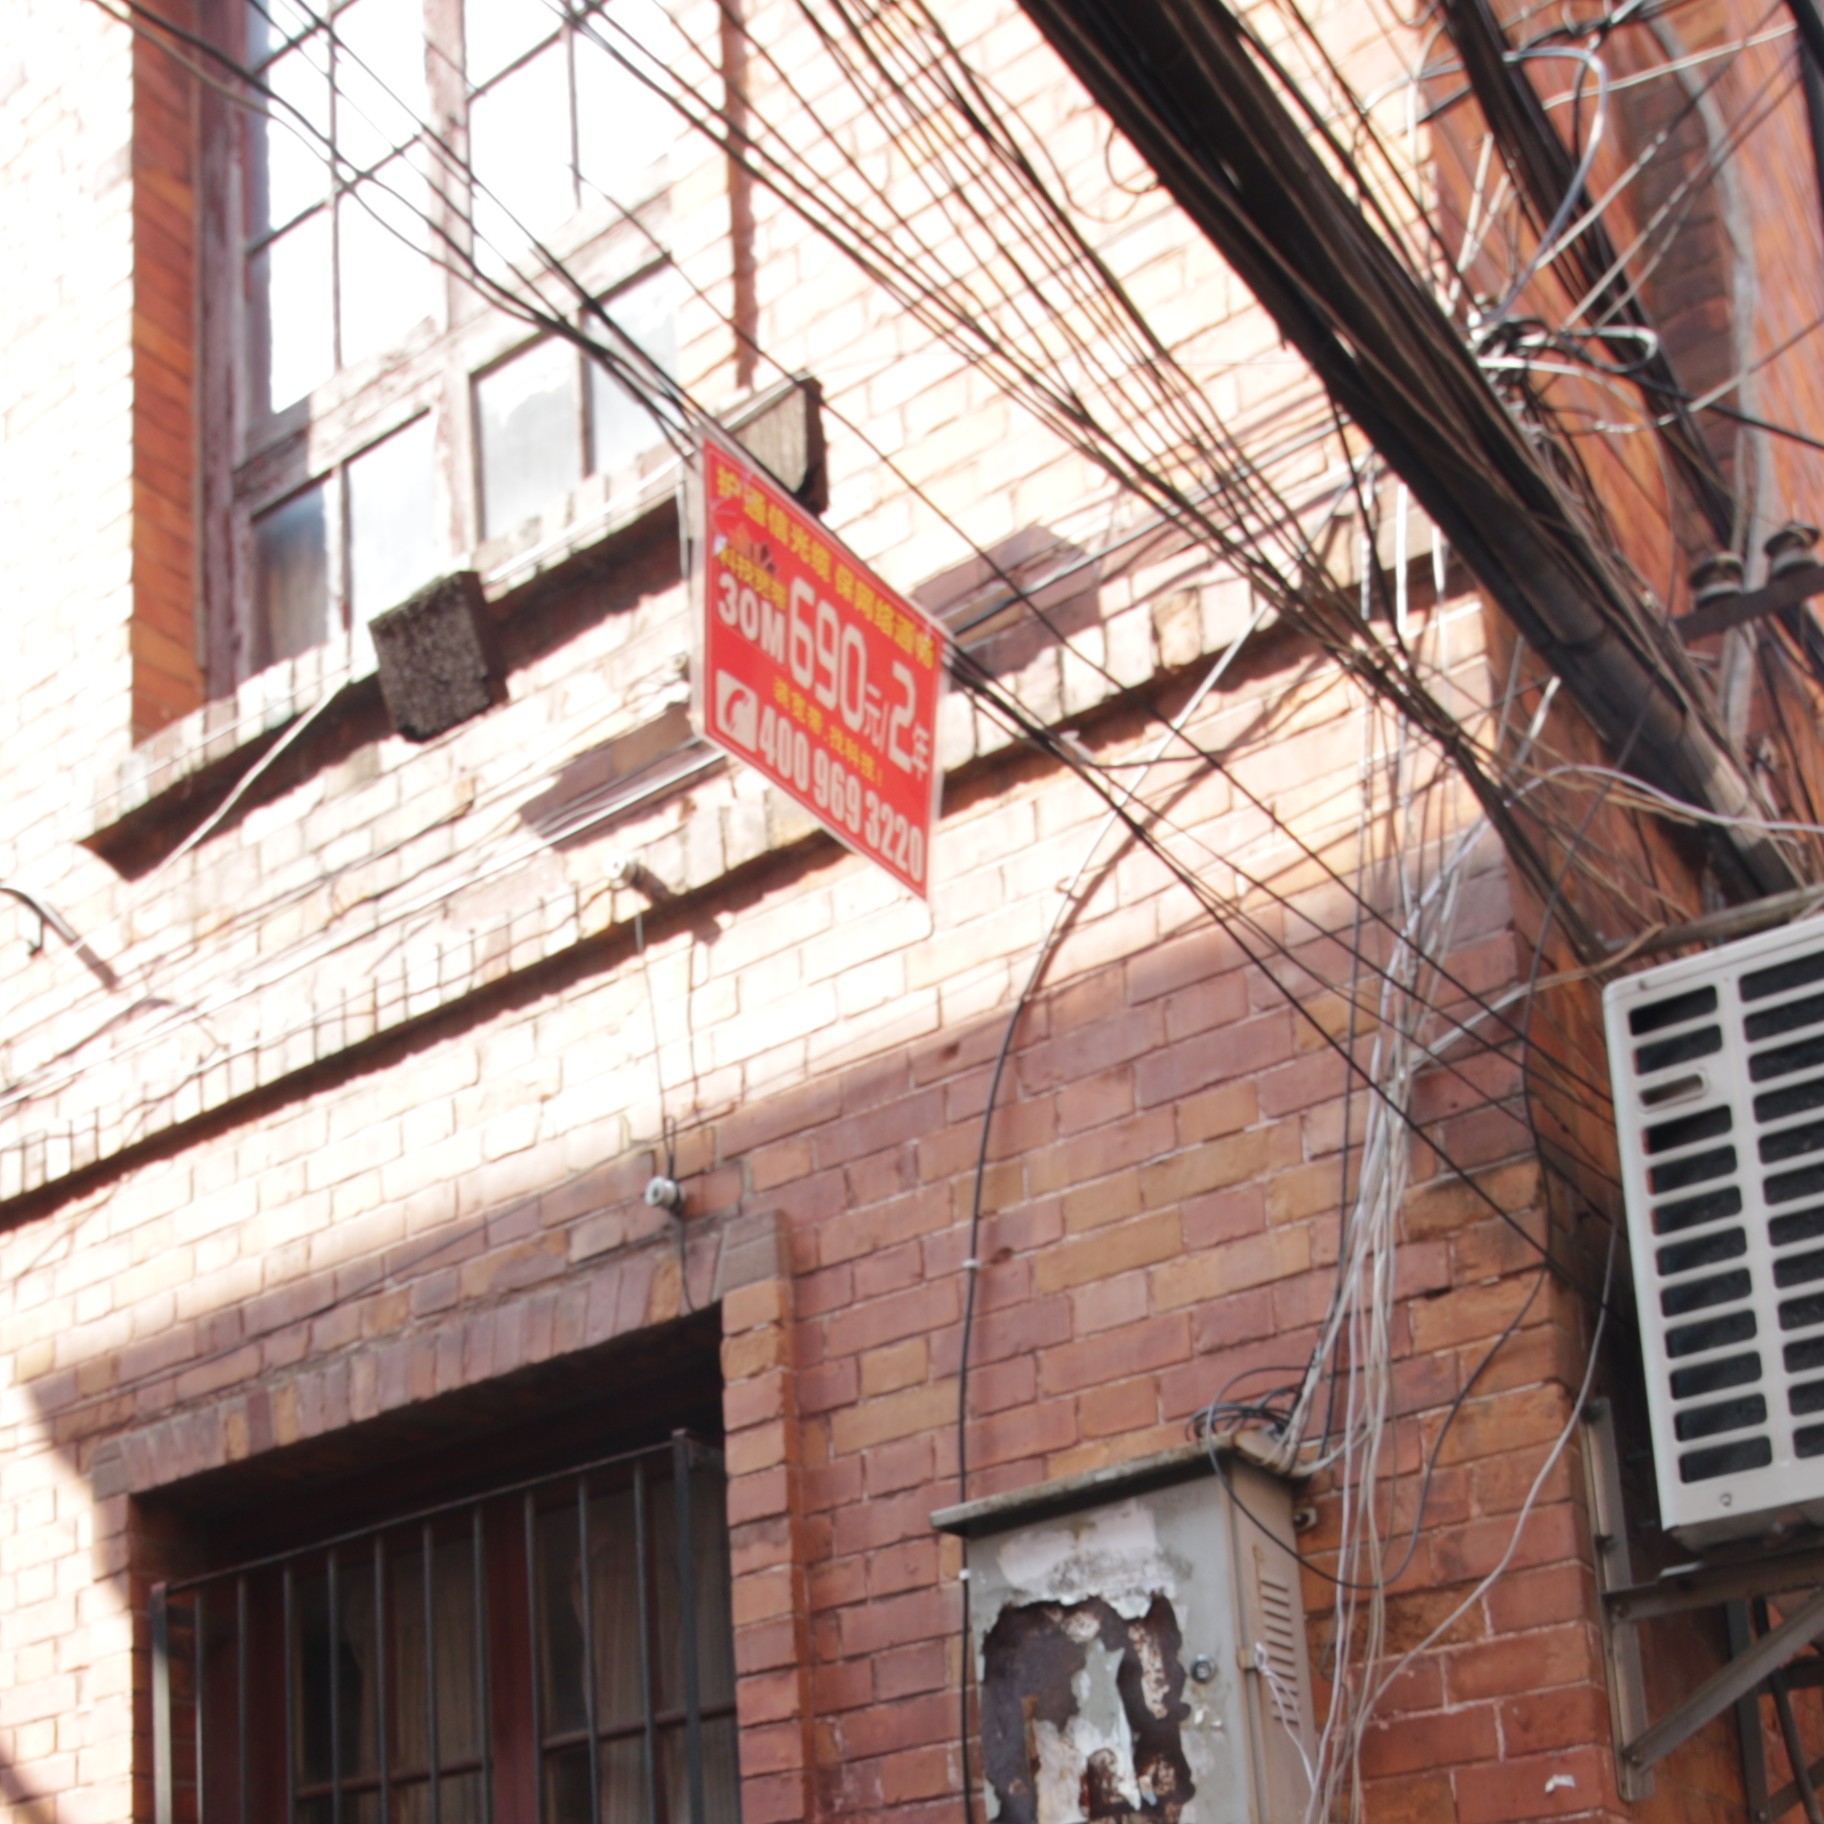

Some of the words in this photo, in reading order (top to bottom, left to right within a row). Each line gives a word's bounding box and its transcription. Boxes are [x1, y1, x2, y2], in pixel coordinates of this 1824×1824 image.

[717, 573, 785, 664] 30M
[758, 706, 810, 793] 400
[813, 748, 862, 835] 969
[864, 793, 923, 883] 3220
